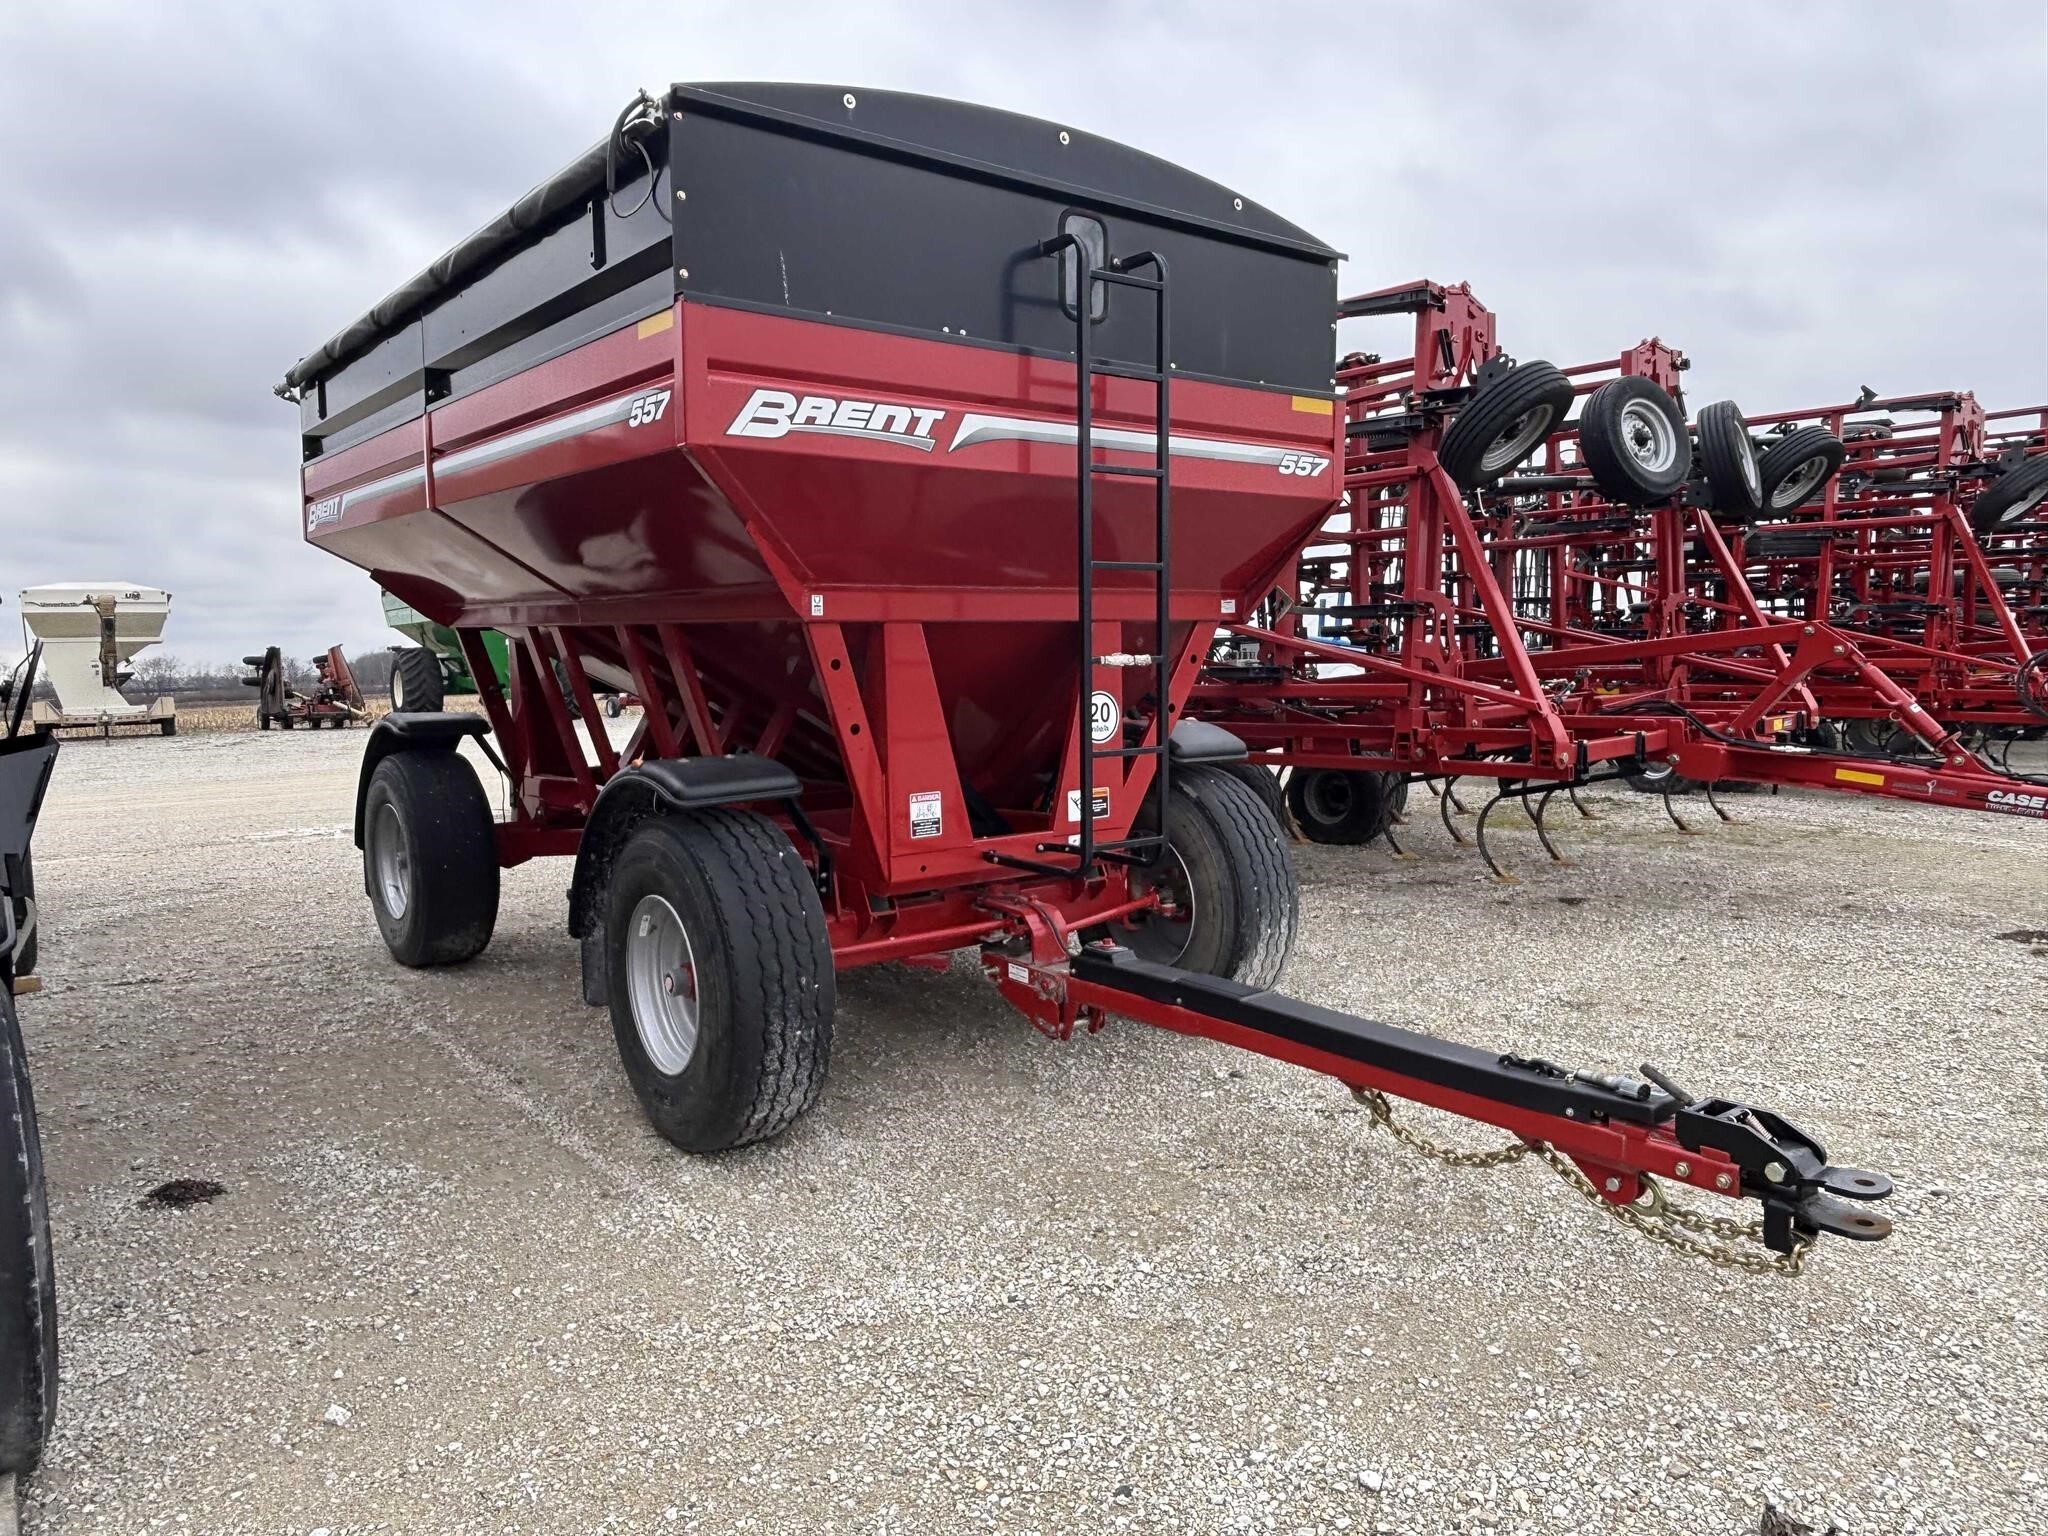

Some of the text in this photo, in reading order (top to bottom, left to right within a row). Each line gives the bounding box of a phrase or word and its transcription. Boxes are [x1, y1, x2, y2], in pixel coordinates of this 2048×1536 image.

[628, 390, 672, 428] 557
[726, 389, 946, 438] BRENT
[1278, 454, 1330, 477] 557
[307, 496, 341, 532] BRENT
[1987, 790, 2047, 808] CASE
